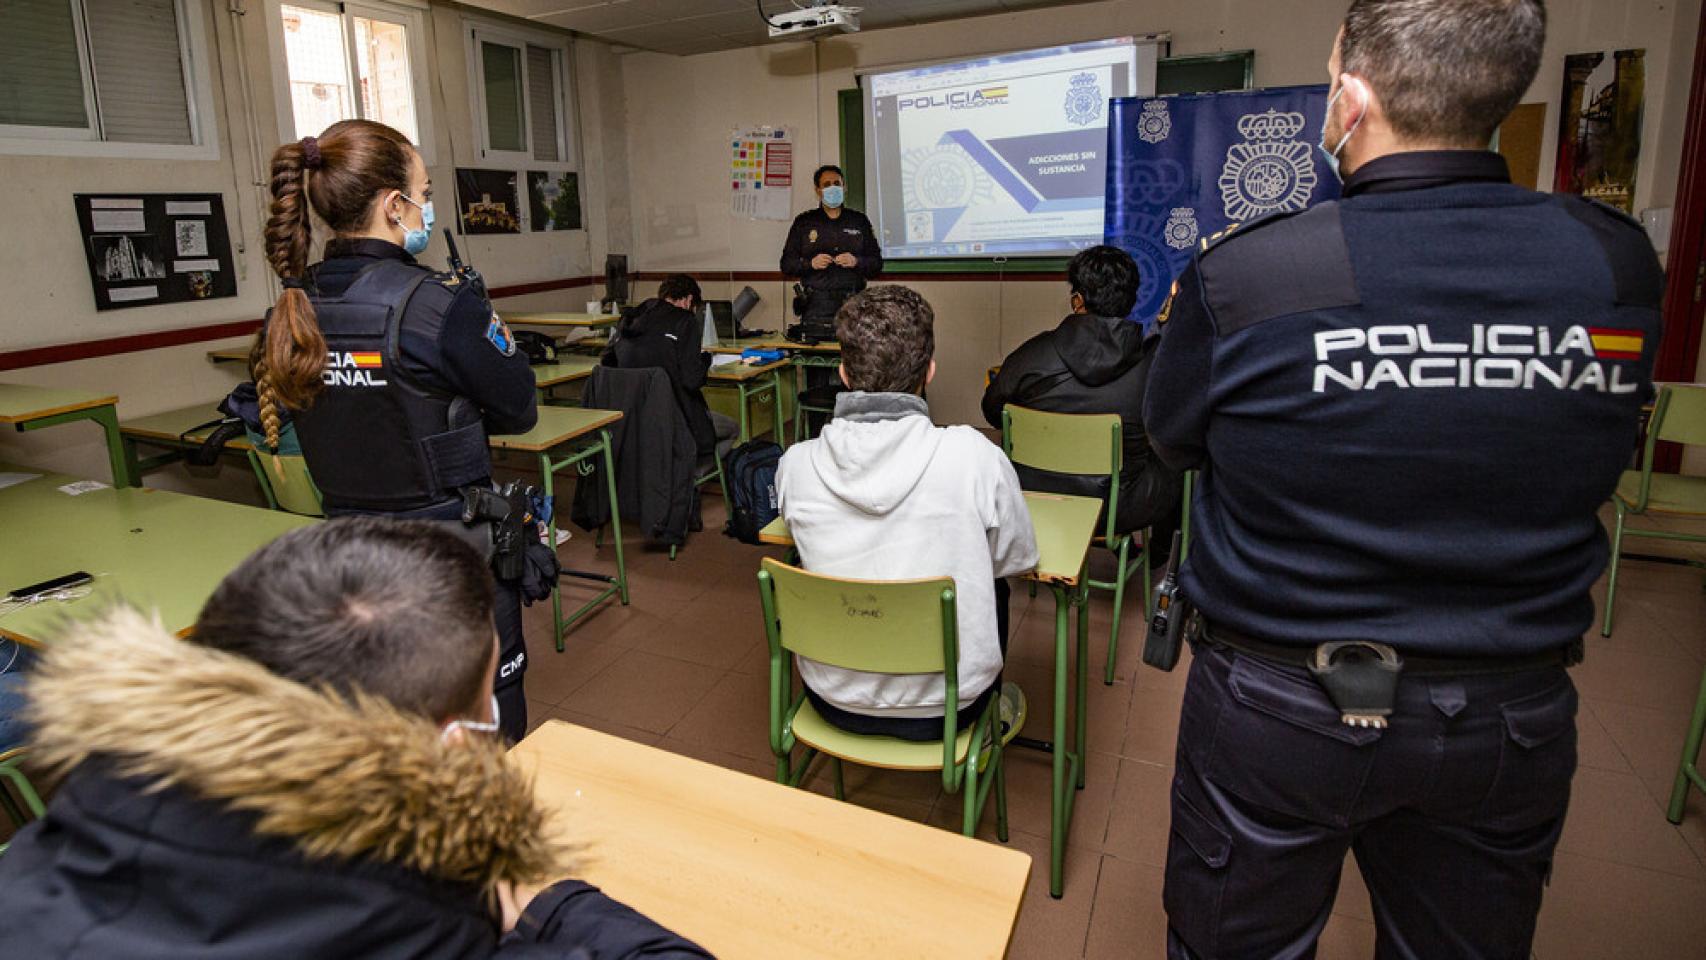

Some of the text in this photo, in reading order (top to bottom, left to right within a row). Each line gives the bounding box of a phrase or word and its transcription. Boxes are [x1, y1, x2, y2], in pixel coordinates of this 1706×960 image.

[898, 89, 985, 111] POLICIA
[950, 98, 1009, 111] NACIONAL
[1028, 151, 1096, 164] ADICCIONES SIN
[1038, 163, 1086, 175] SUSTANCIA
[1313, 323, 1596, 361] POLICIA
[321, 369, 388, 386] ONAL
[1312, 357, 1638, 393] NACIONAL
[500, 652, 525, 677] CNP
